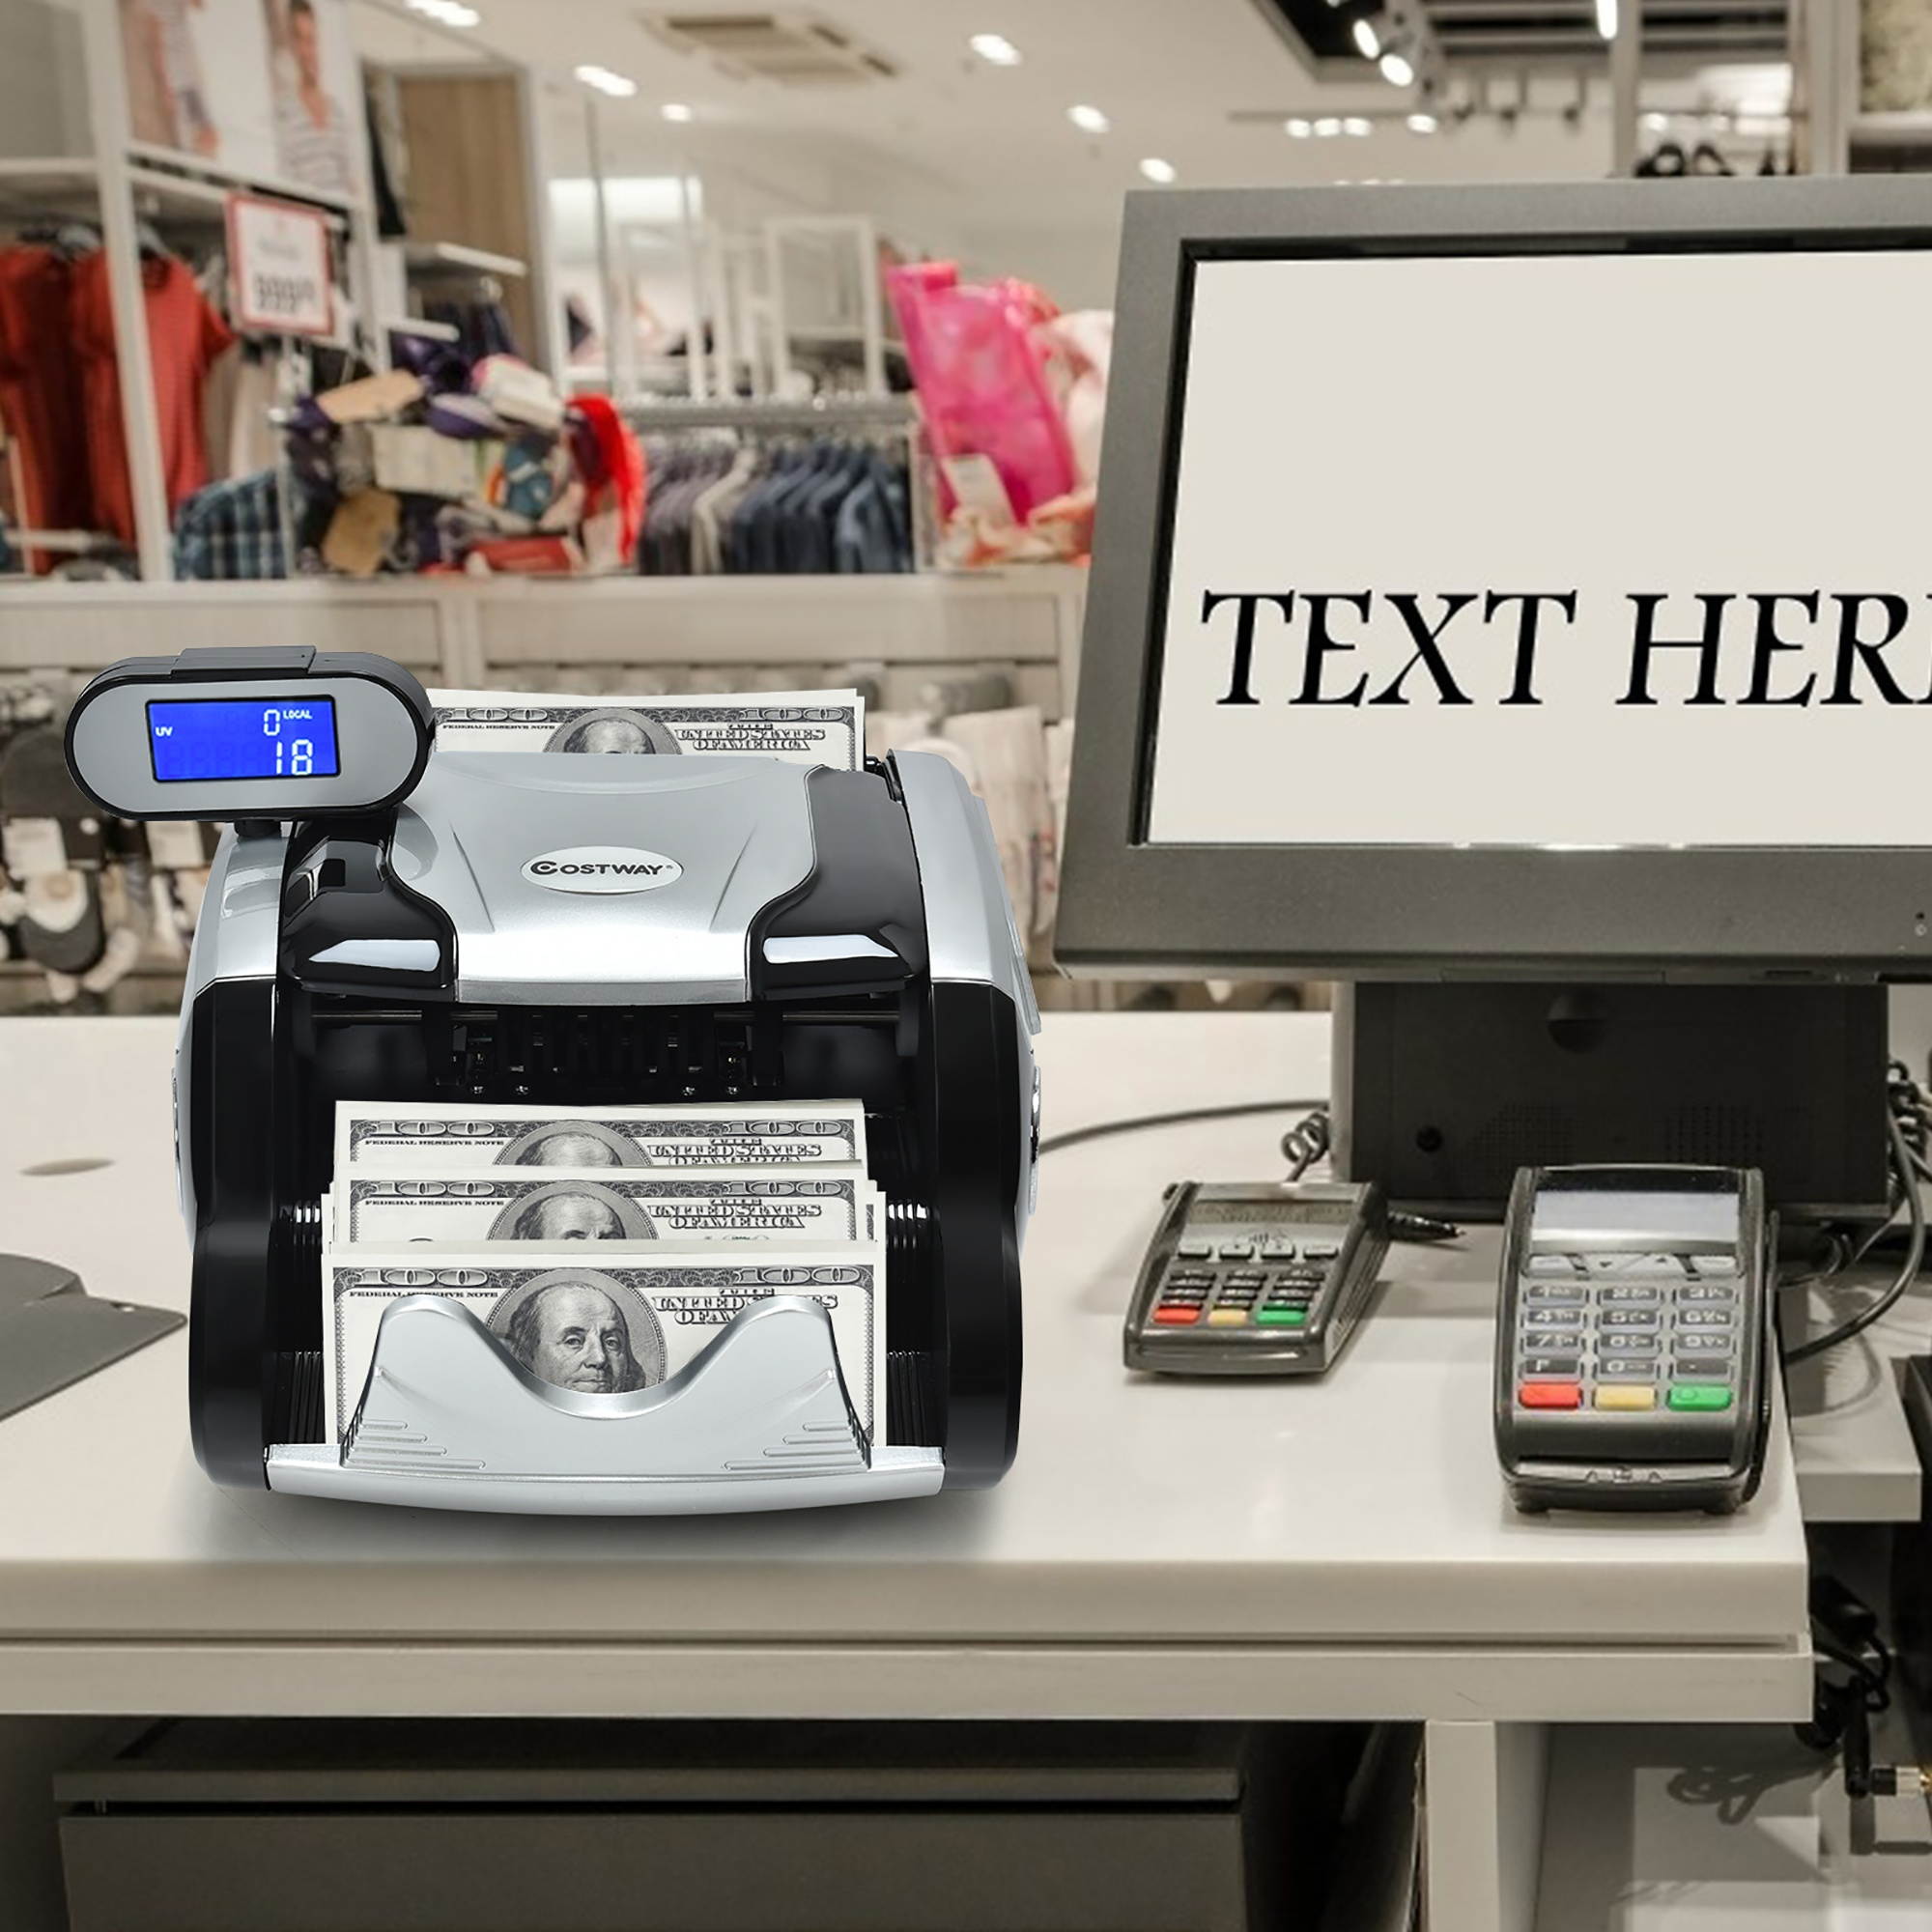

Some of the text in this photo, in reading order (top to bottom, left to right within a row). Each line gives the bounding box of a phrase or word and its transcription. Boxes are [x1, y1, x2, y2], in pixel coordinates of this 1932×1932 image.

[1202, 590, 1932, 707] TEXT HER
[264, 709, 312, 736] 0 LOCAL
[739, 708, 843, 722] 100
[155, 726, 172, 736] UV
[675, 729, 826, 740] UNITED STATES
[719, 739, 810, 750] AMERICA
[276, 739, 313, 776] 18
[370, 1121, 496, 1137] 100
[724, 1120, 843, 1135] 100
[647, 1144, 821, 1156] UNITED STATES
[370, 1180, 496, 1197] 100
[724, 1180, 842, 1196] 100
[647, 1205, 821, 1217] UNITED STATES
[696, 1216, 806, 1228] AMERICA
[354, 1268, 488, 1287] 100
[732, 1266, 861, 1285] 100
[651, 1296, 745, 1311] UNITED
